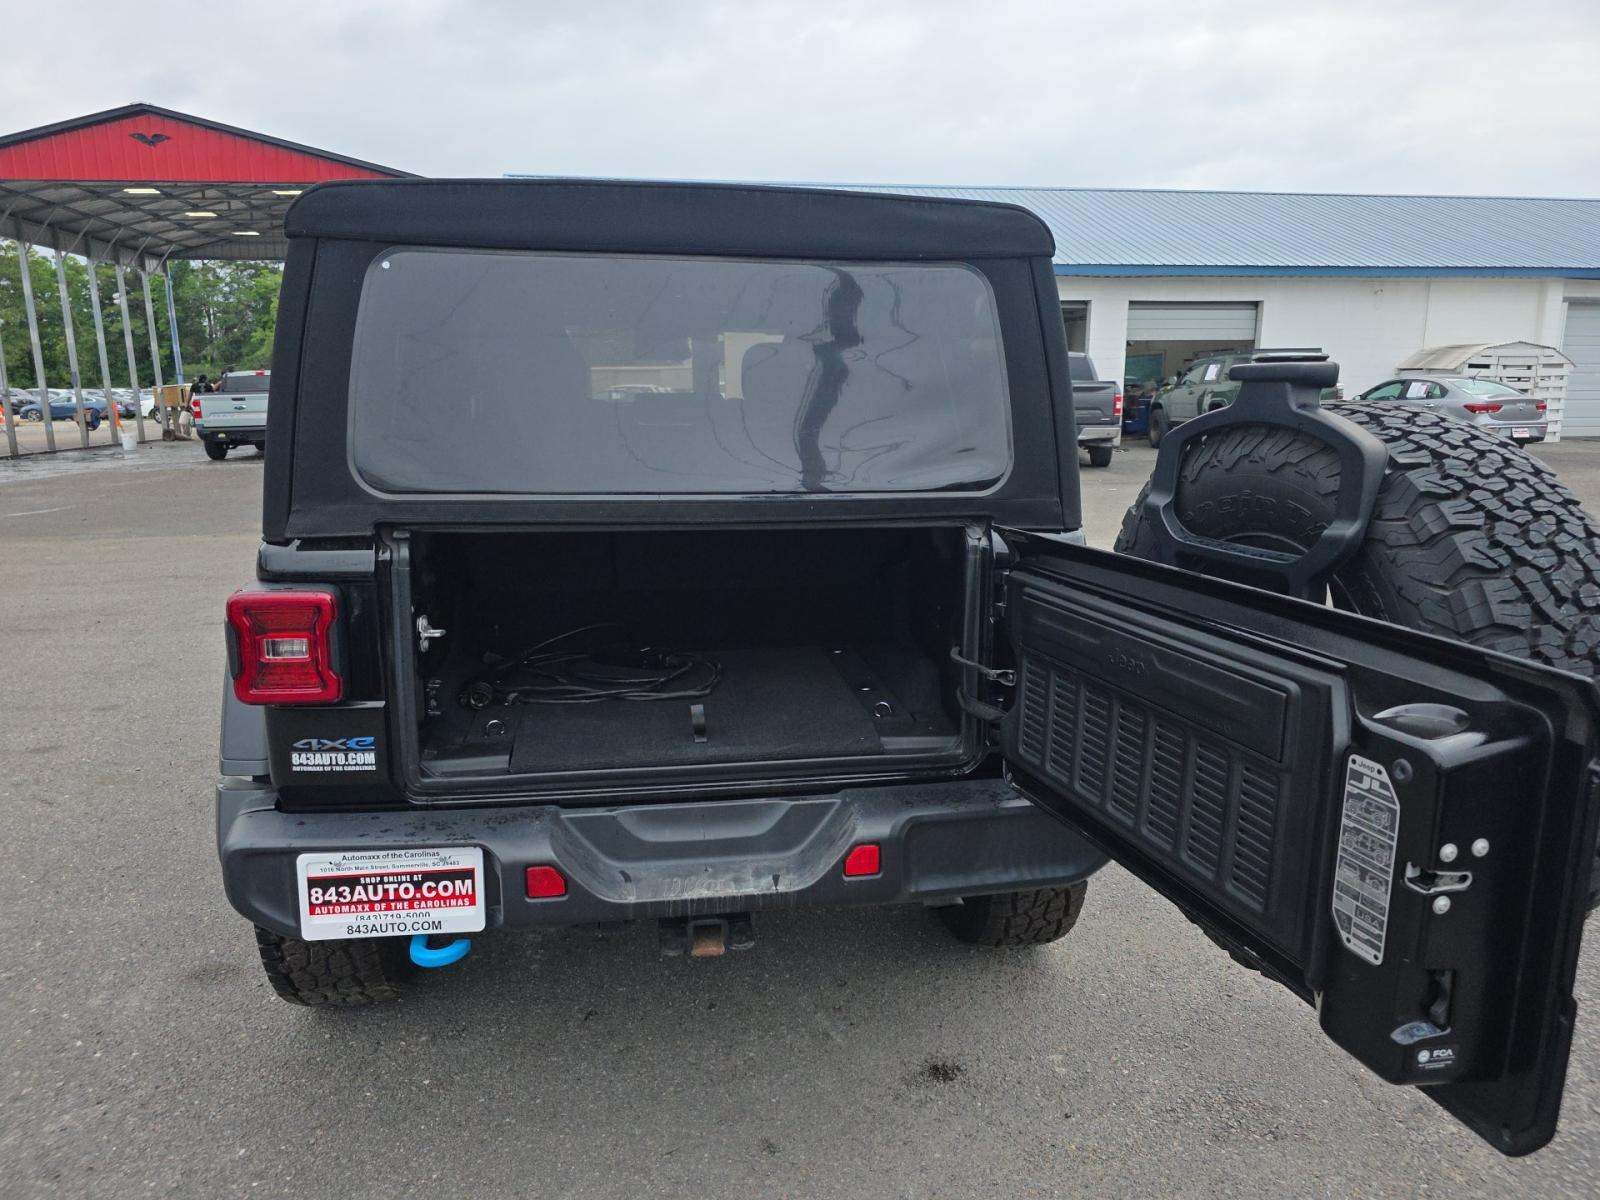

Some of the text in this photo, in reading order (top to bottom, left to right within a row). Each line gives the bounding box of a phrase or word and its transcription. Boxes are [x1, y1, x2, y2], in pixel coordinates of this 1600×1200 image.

[291, 752, 376, 765] 843AUTO.COM
[1358, 761, 1376, 773] Jeep
[1349, 775, 1392, 798] JL
[341, 854, 381, 862] Automaxx
[403, 850, 440, 859] Carolinas
[336, 865, 353, 873] North
[360, 876, 381, 884] SHOP
[384, 875, 411, 883] ONLINE
[310, 879, 473, 905] 843AUTO.COM
[314, 898, 470, 915] AUTOMAXX OF THE CAROLINAS
[346, 920, 443, 935] 843AUTO.COM
